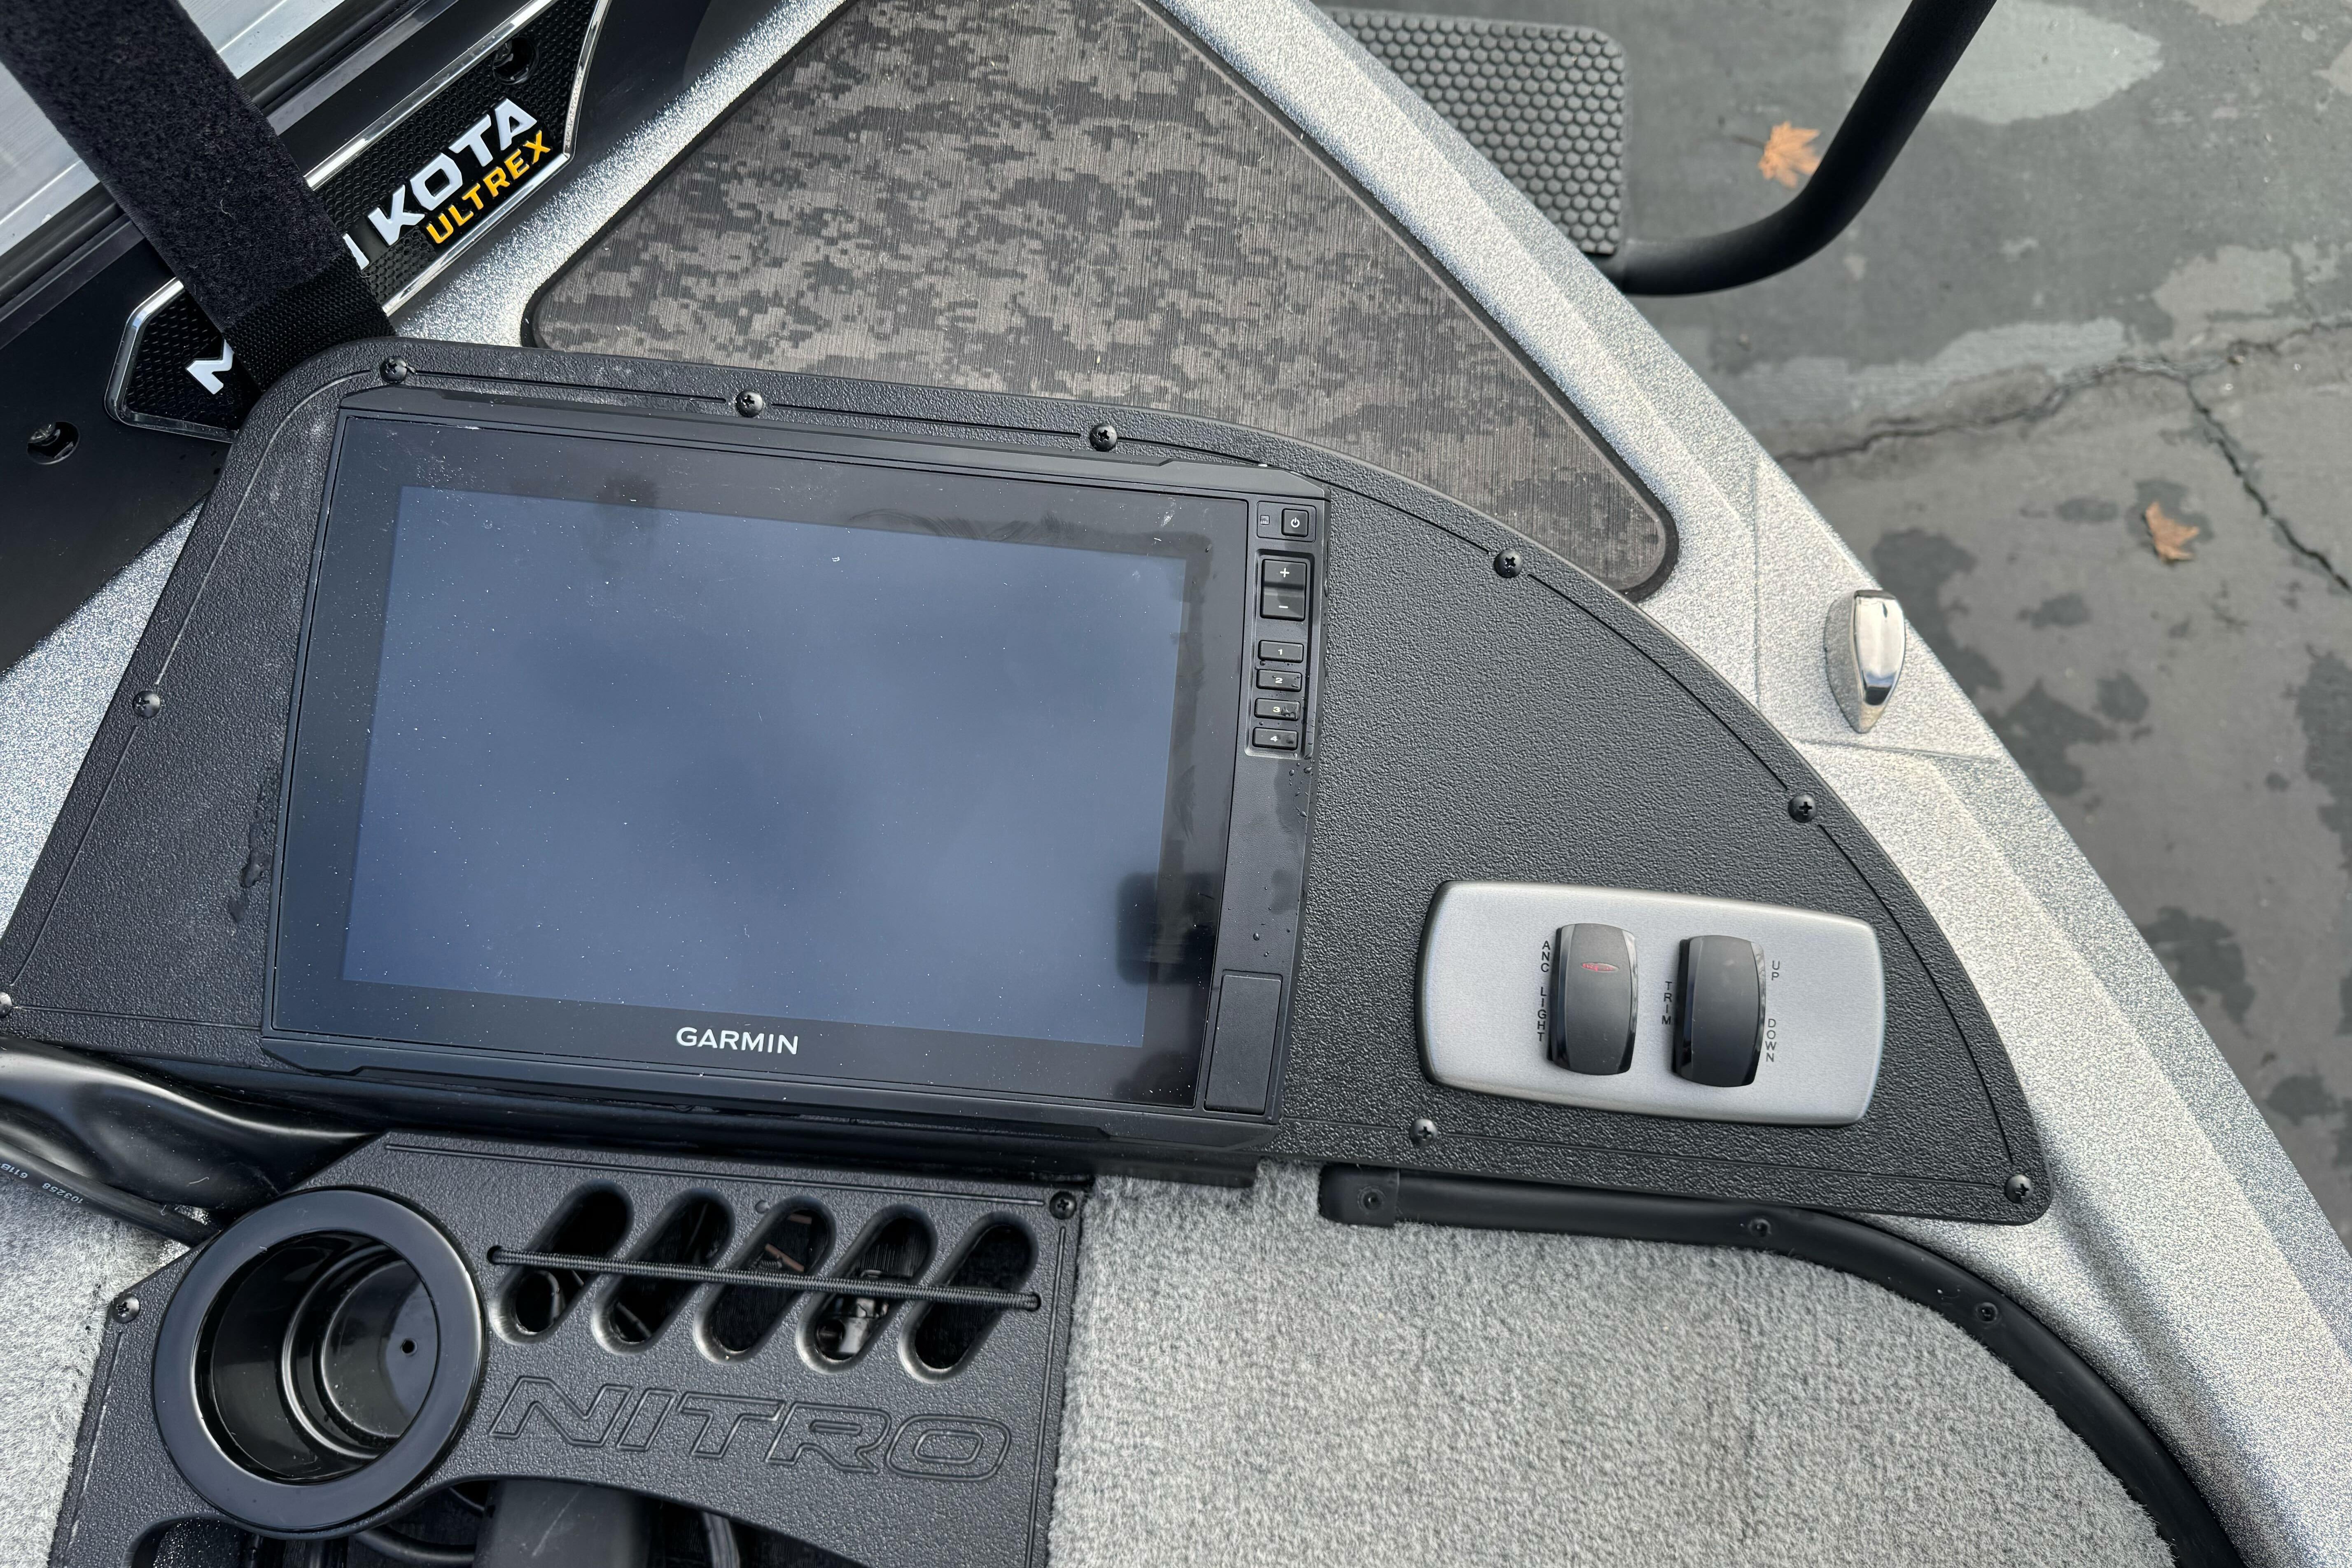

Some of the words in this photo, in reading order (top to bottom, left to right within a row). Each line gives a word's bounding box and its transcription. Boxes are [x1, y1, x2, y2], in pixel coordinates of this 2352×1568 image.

[367, 98, 537, 246] KOTA
[425, 130, 551, 244] ULTREX
[1540, 940, 1551, 973] ANC
[1771, 960, 1780, 981] UP
[1537, 986, 1548, 1042] LIGHT
[1661, 981, 1673, 1026] TRIM
[676, 1027, 798, 1055] GARMIN
[1764, 1018, 1777, 1062] DOWN
[0, 1163, 28, 1179] 611B
[42, 1183, 84, 1204] 103258
[489, 1374, 1012, 1482] NITRO
